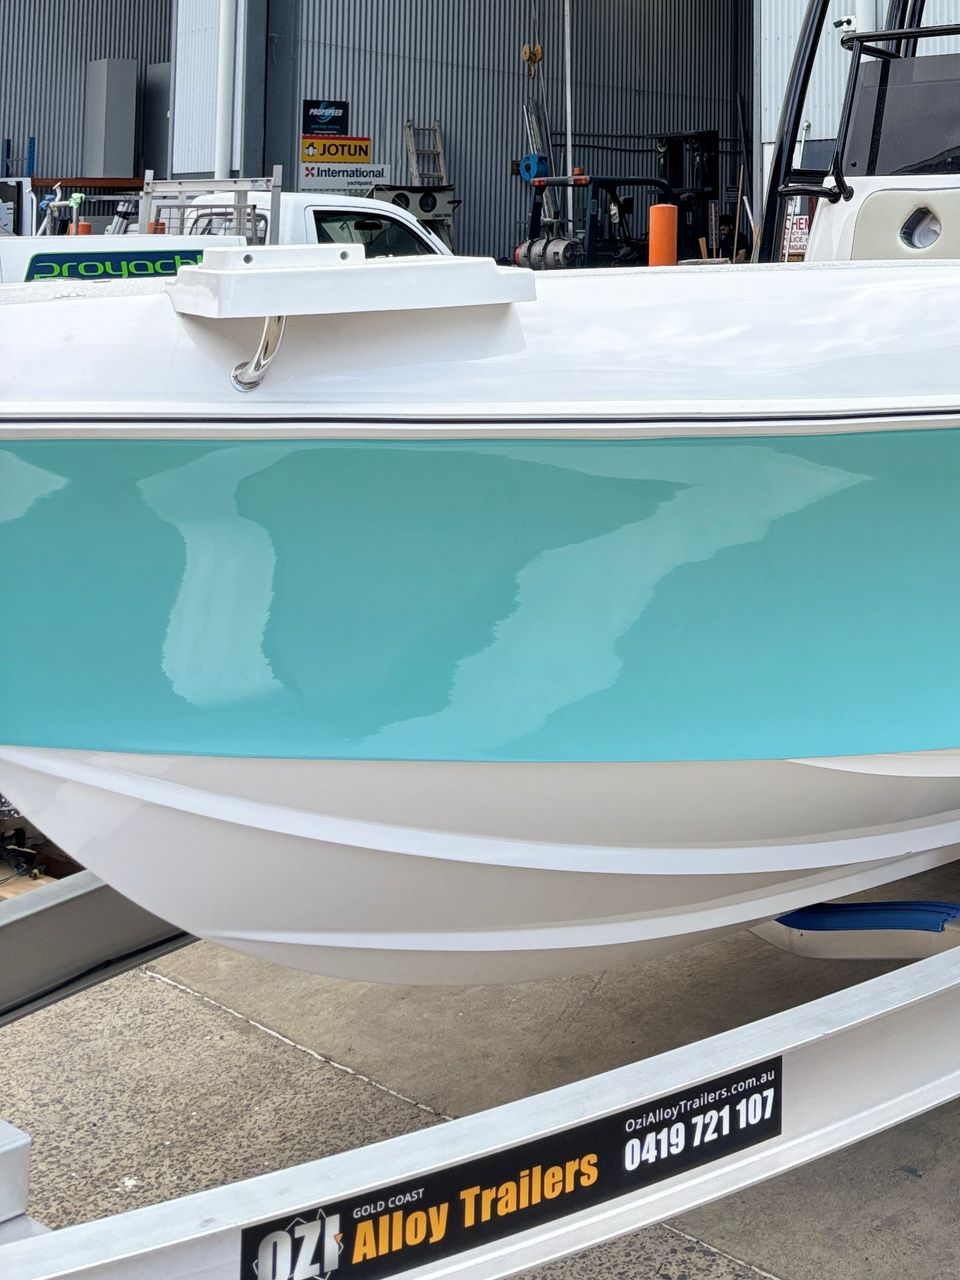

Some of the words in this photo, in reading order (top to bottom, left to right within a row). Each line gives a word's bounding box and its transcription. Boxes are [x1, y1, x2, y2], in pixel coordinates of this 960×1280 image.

[320, 143, 369, 157] JOTUN
[34, 254, 204, 279] proyach
[625, 1070, 775, 1132] OziAlloyTrailers.com.au
[624, 1122, 686, 1171] 0419
[691, 1104, 730, 1147] 721
[736, 1087, 775, 1129] 107
[257, 1213, 340, 1280] OZI
[352, 1202, 449, 1264] Alloy
[459, 1153, 599, 1228] Trailers
[353, 1201, 385, 1219] GOLD
[388, 1188, 425, 1208] COAST
